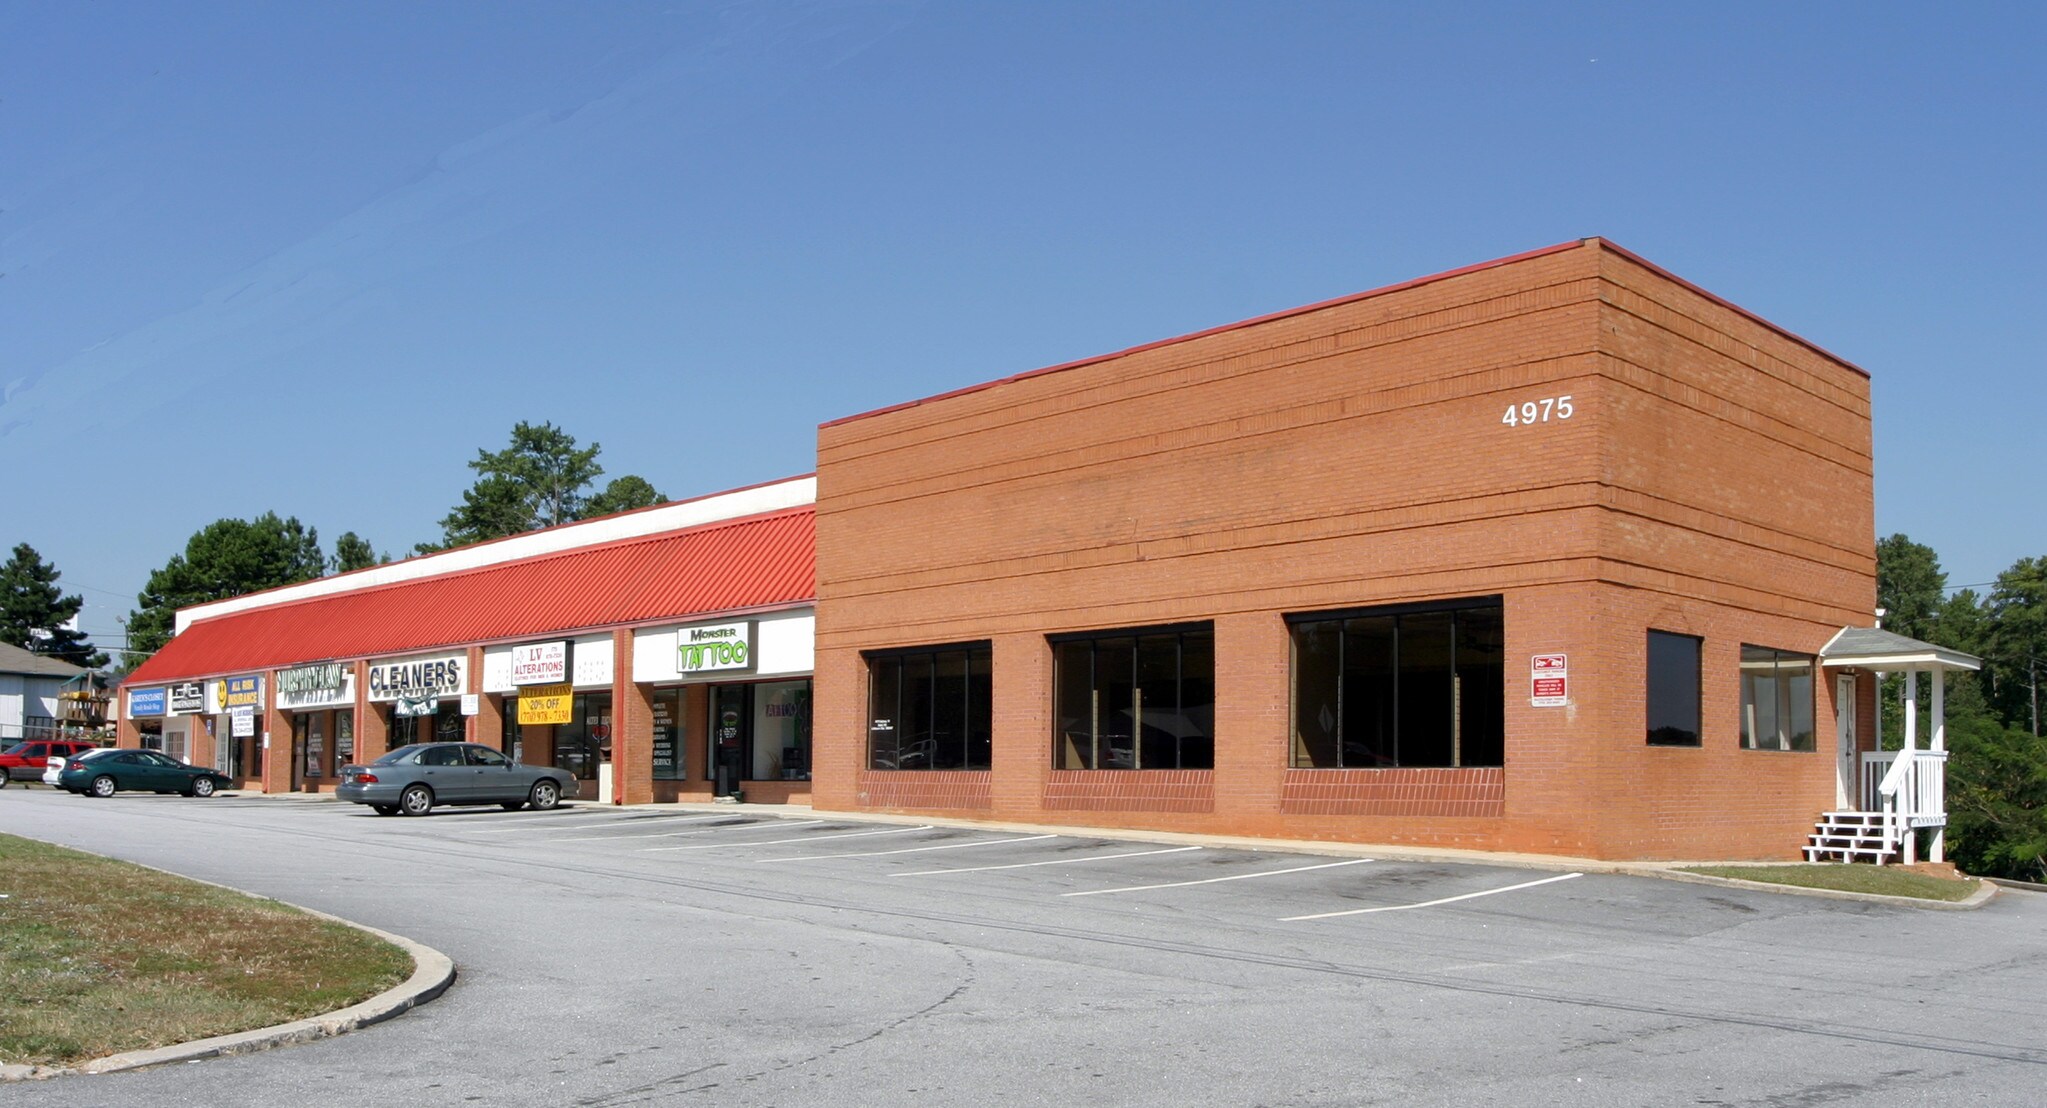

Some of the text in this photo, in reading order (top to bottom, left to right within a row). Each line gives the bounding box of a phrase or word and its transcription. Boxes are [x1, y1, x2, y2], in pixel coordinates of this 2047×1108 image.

[1502, 395, 1574, 427] 4975
[529, 648, 543, 661] LV
[679, 640, 748, 671] TATTOO
[370, 659, 458, 690] CLEANERS
[514, 661, 564, 675] ALTERATIONS
[231, 681, 241, 692] ALL
[228, 692, 258, 706] INSURANCE
[530, 698, 560, 710] 20% OFF
